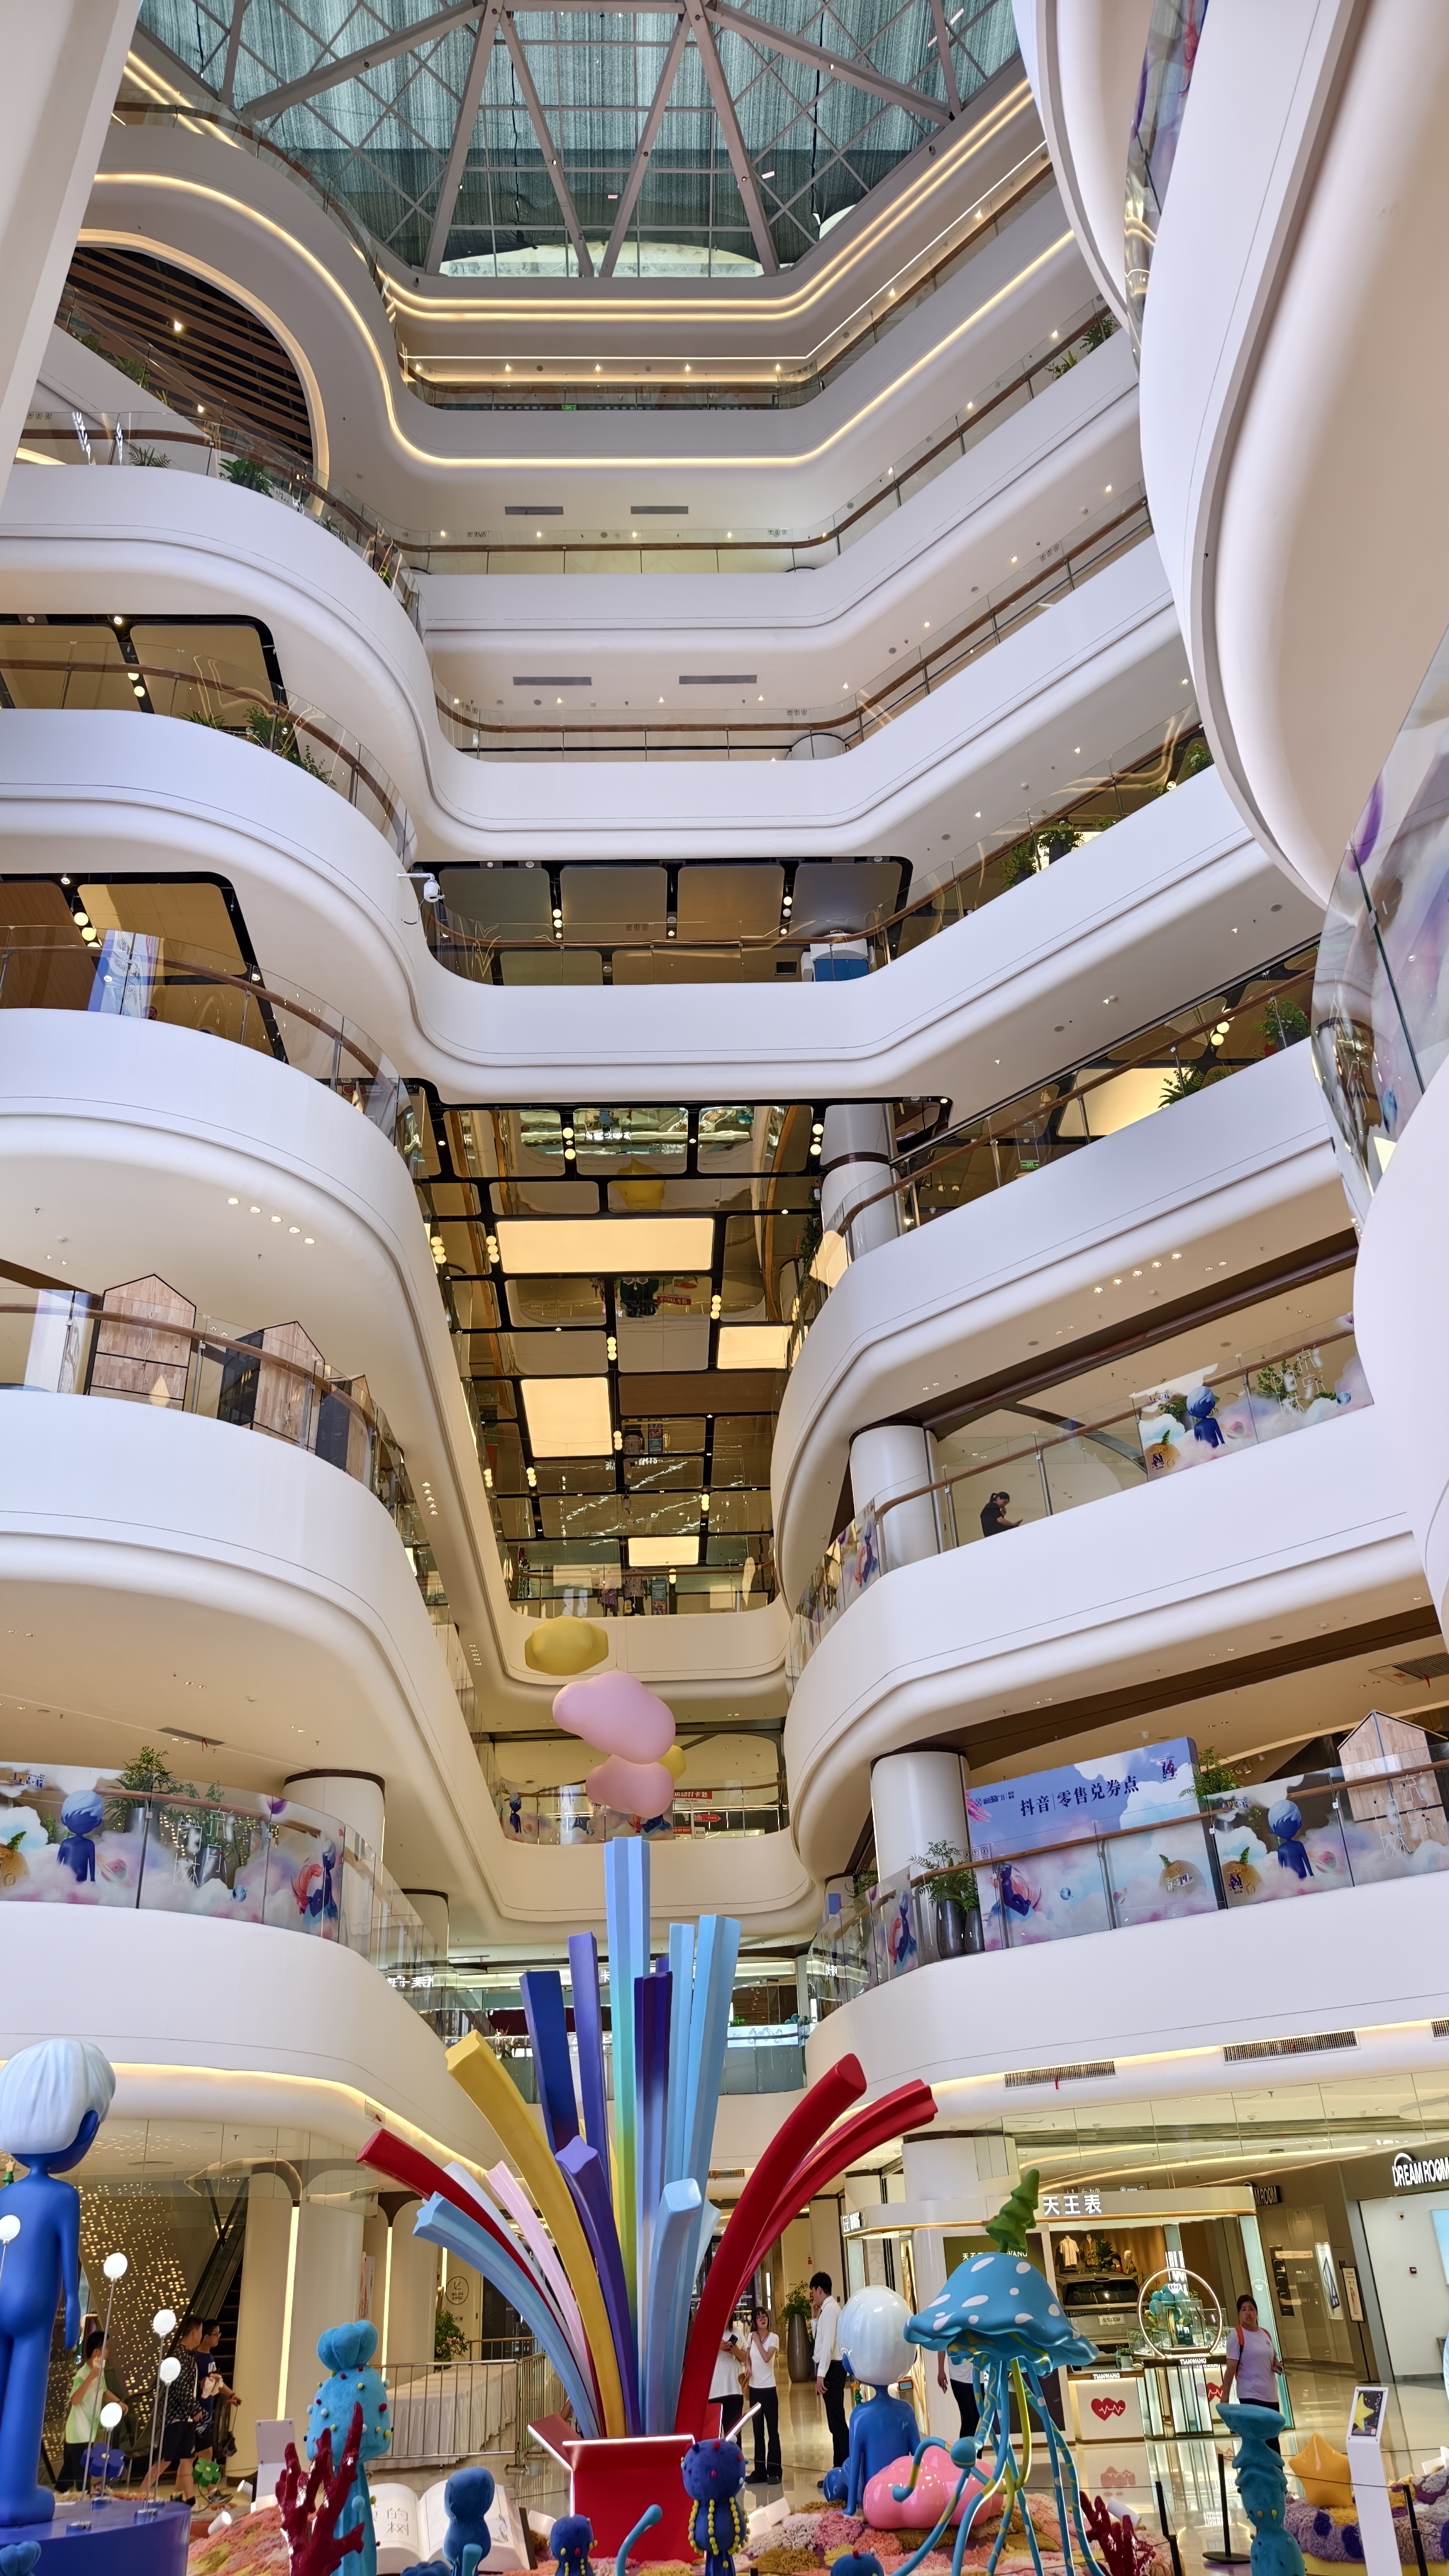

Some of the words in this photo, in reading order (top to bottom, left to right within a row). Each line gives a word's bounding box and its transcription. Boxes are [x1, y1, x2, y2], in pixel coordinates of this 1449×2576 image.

[1392, 2159, 1424, 2187] DREAM
[1424, 2156, 1449, 2183] ROOM
[1042, 2194, 1102, 2217] 天王表
[1260, 2185, 1278, 2205] ROOM
